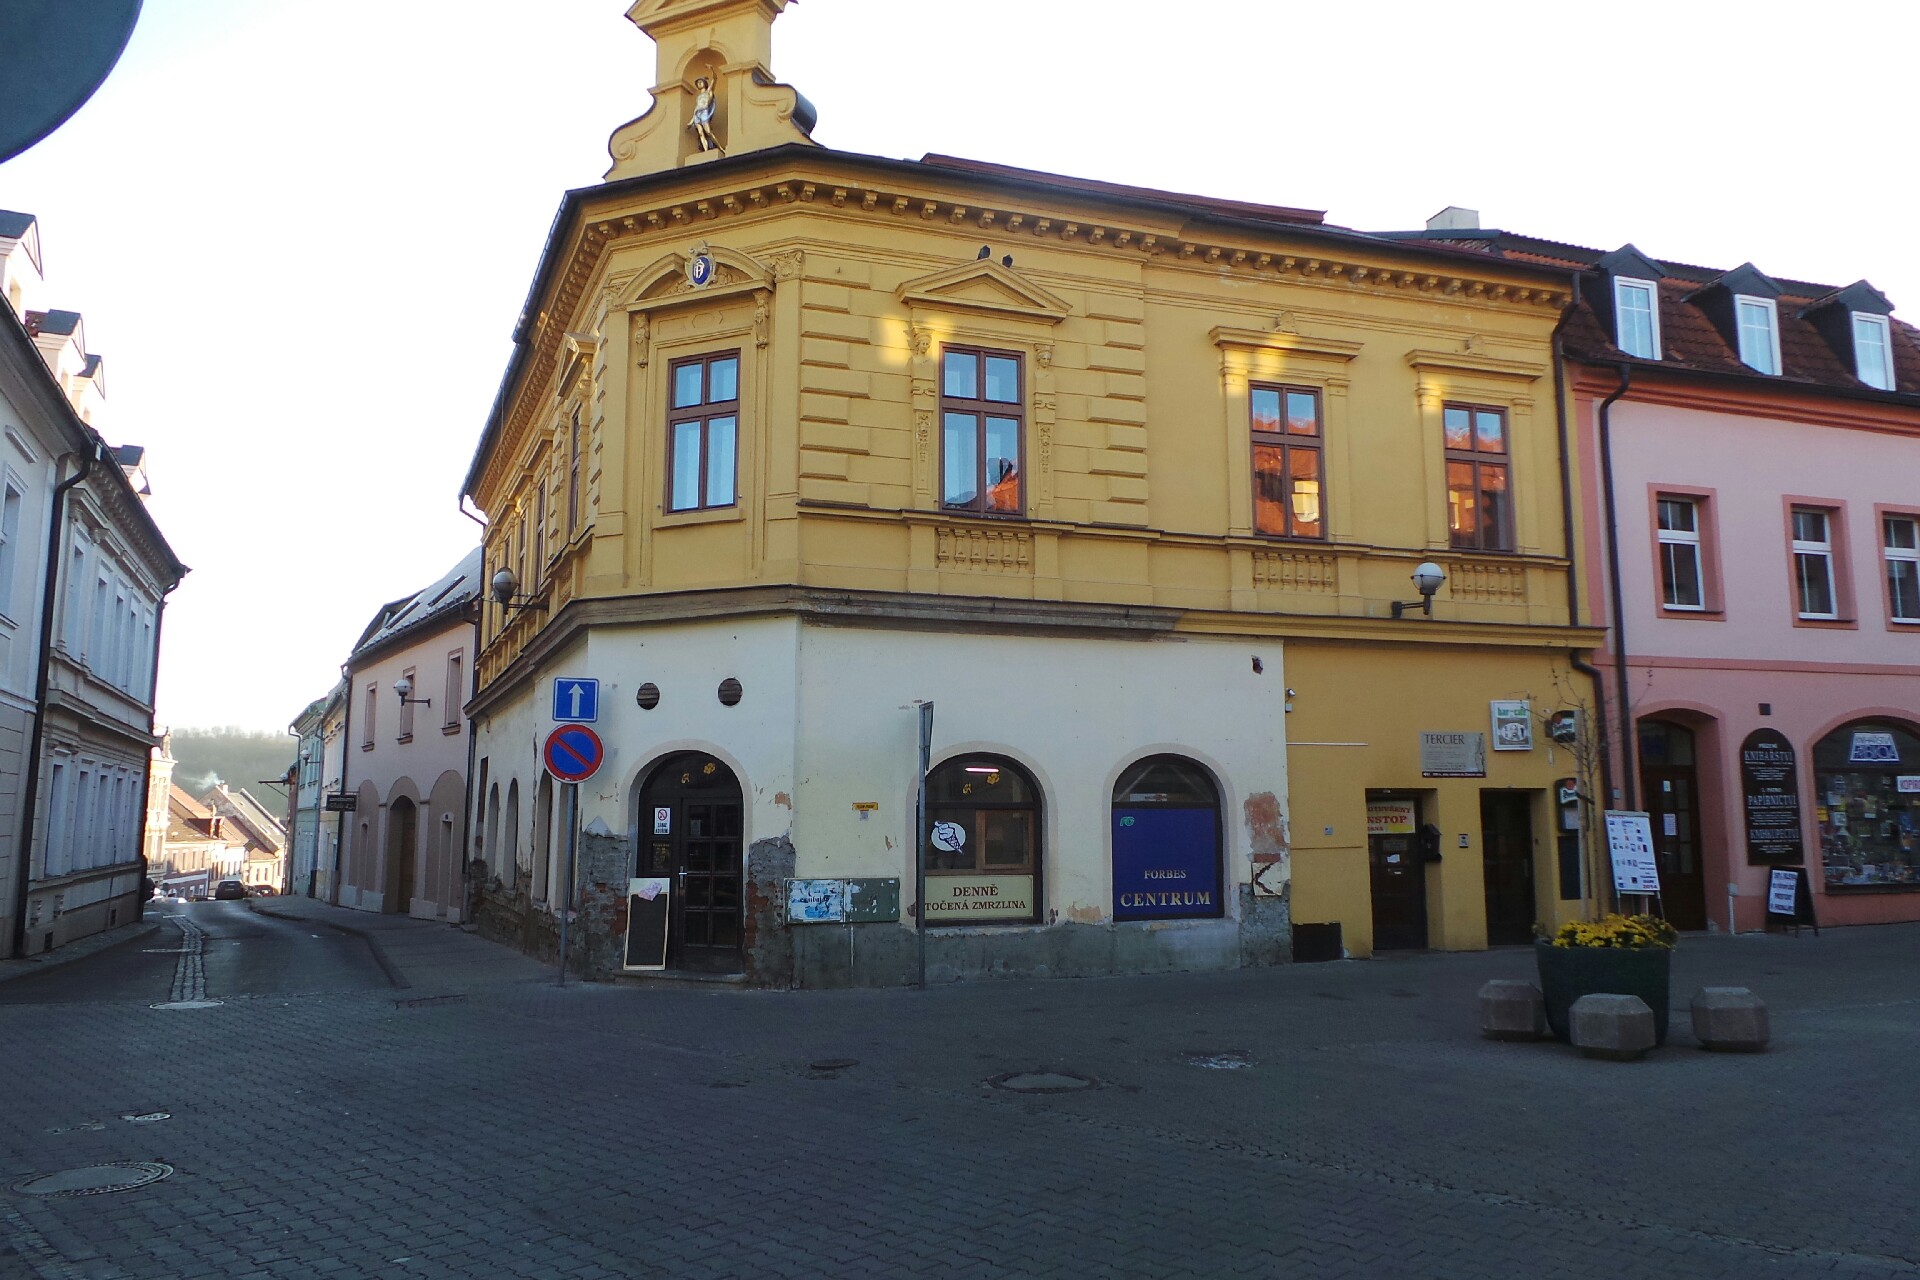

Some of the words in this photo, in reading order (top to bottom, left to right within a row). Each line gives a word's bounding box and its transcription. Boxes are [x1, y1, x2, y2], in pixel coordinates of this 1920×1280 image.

[1424, 734, 1465, 745] TERCIER
[1144, 869, 1187, 880] FORBES
[952, 883, 999, 897] DENNĚ
[925, 899, 969, 911] TOČENÁ
[972, 900, 1026, 910] ZMRZLINA
[1120, 891, 1211, 907] CENTRUM
